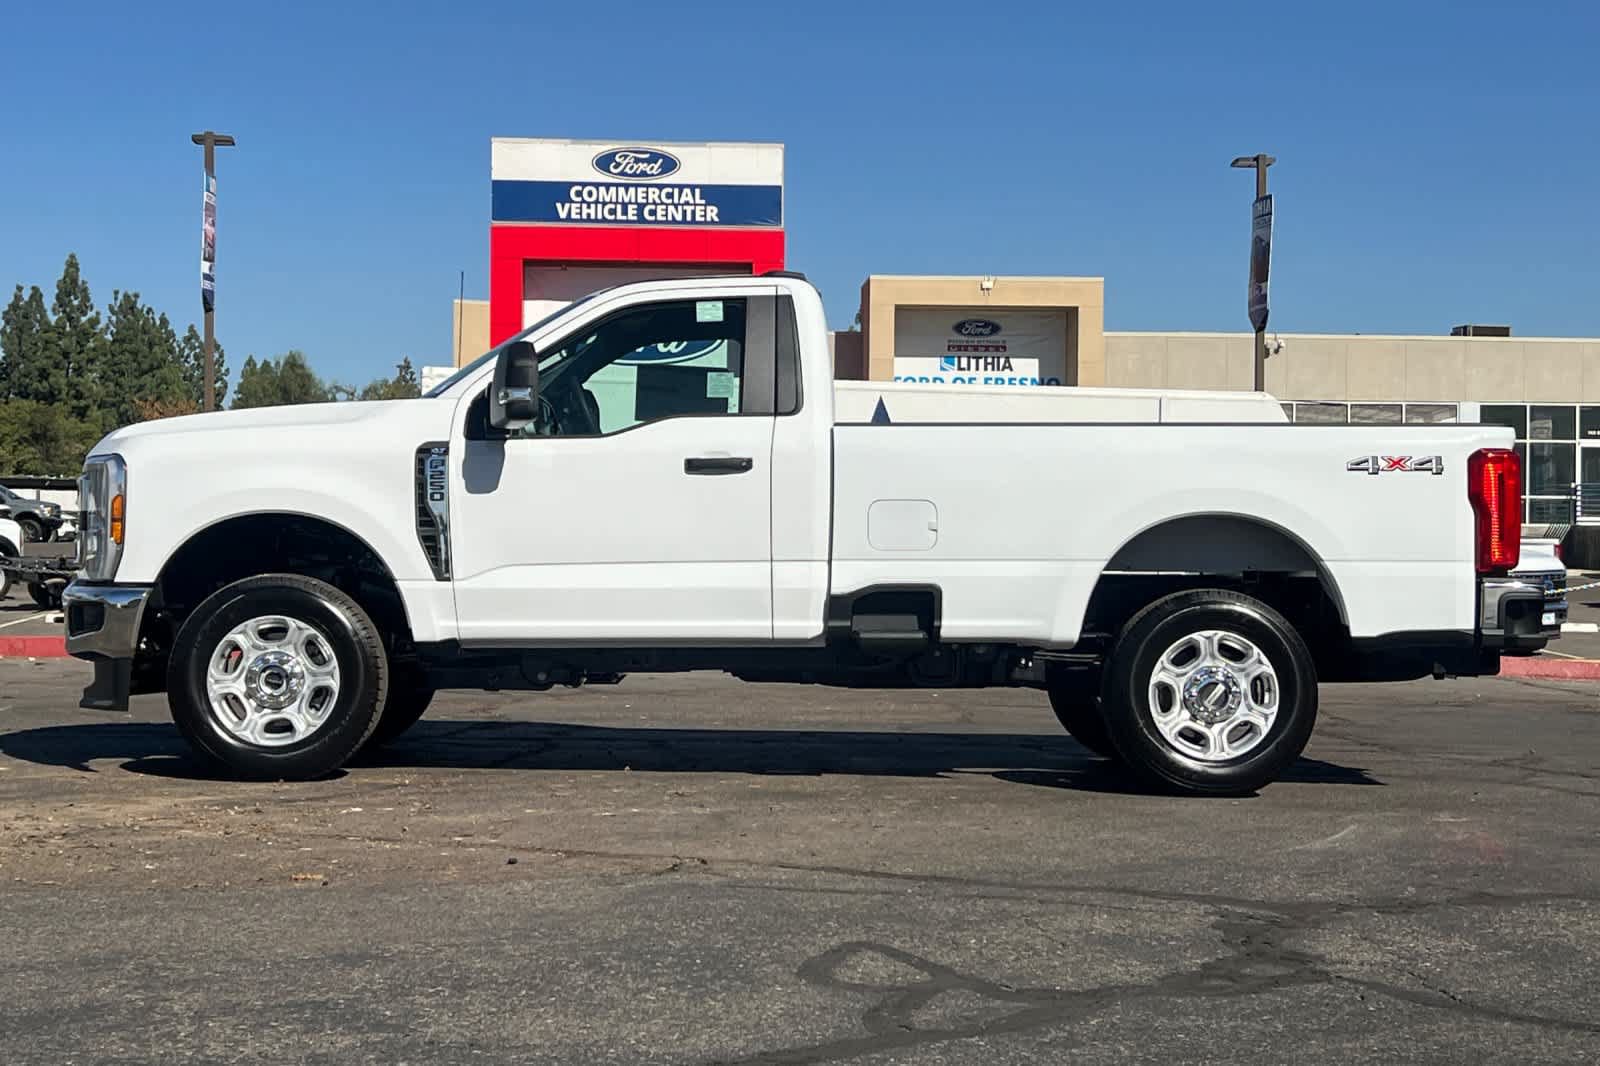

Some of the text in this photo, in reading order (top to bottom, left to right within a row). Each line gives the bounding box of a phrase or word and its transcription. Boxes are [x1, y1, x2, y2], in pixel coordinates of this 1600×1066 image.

[609, 151, 663, 175] Ford
[569, 185, 706, 204] COMMERCIAL
[556, 202, 719, 222] VEHICLE CENTER
[961, 321, 992, 336] Ford
[956, 356, 1013, 371] LITHIA
